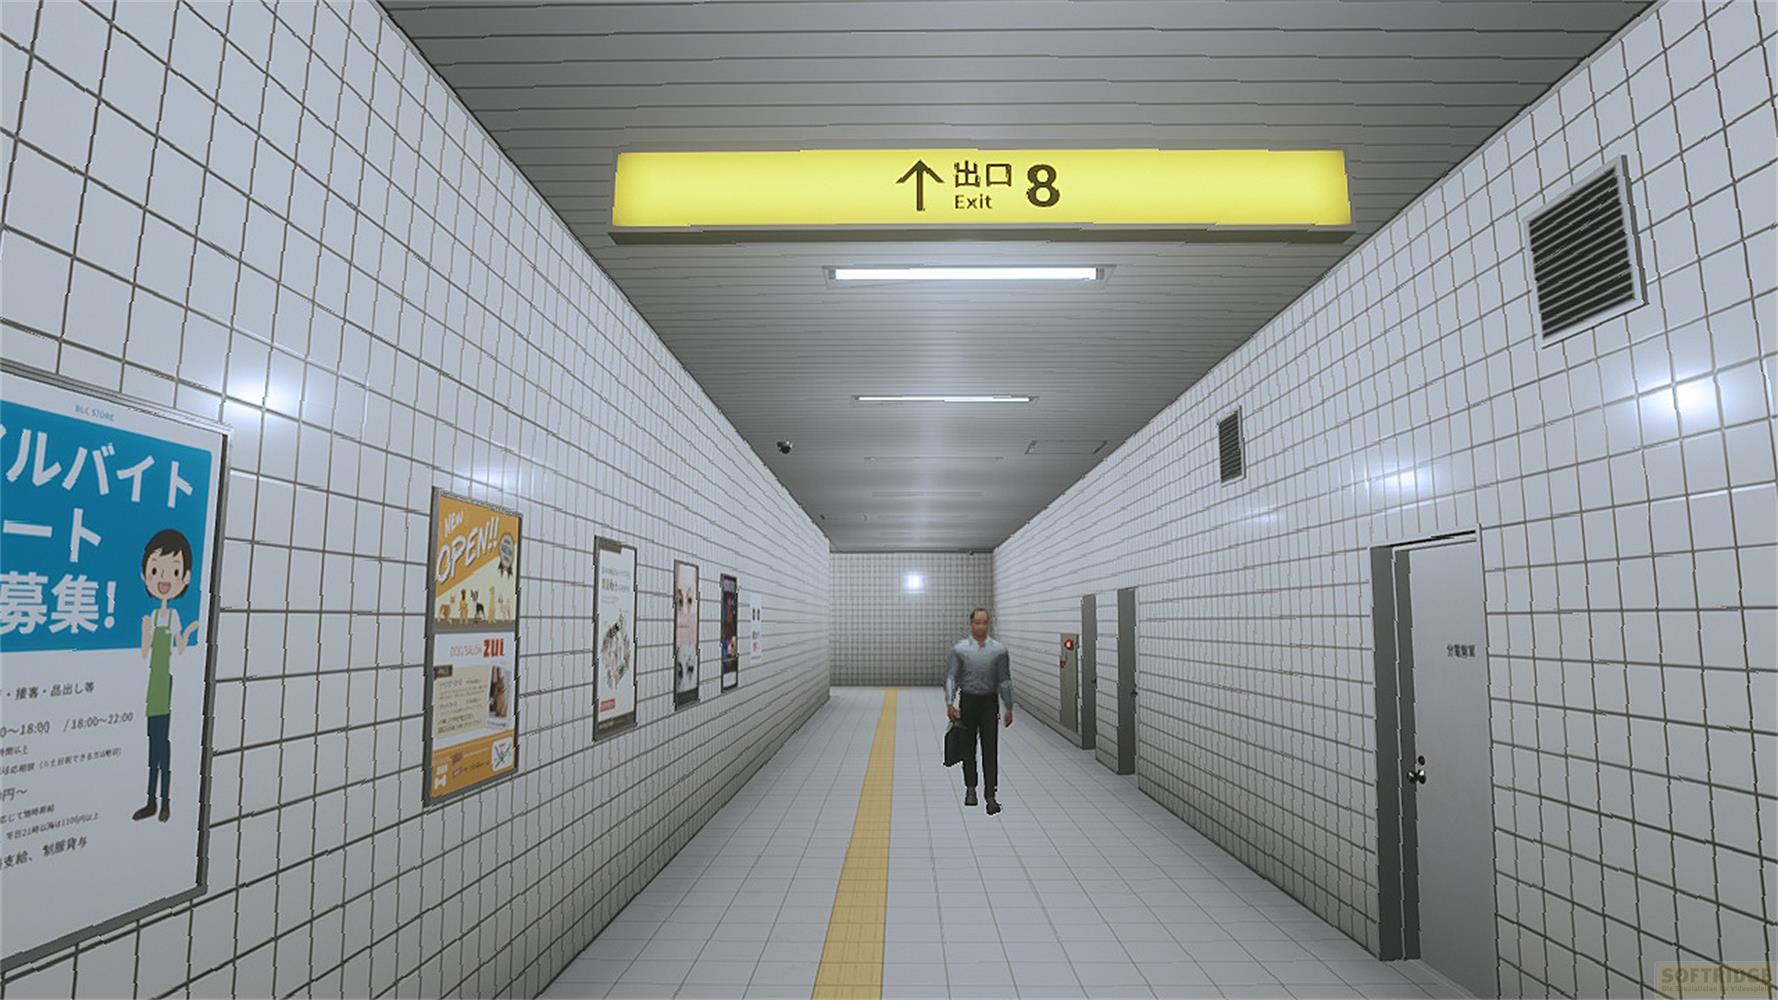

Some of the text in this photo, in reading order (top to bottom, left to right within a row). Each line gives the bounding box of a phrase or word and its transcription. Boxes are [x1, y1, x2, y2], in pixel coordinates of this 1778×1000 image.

[953, 160, 1061, 207] 出口 8
[955, 194, 992, 209] Exit
[0, 425, 194, 509] ルバイト
[444, 511, 464, 537] NEW
[435, 514, 501, 584] OPEN!!
